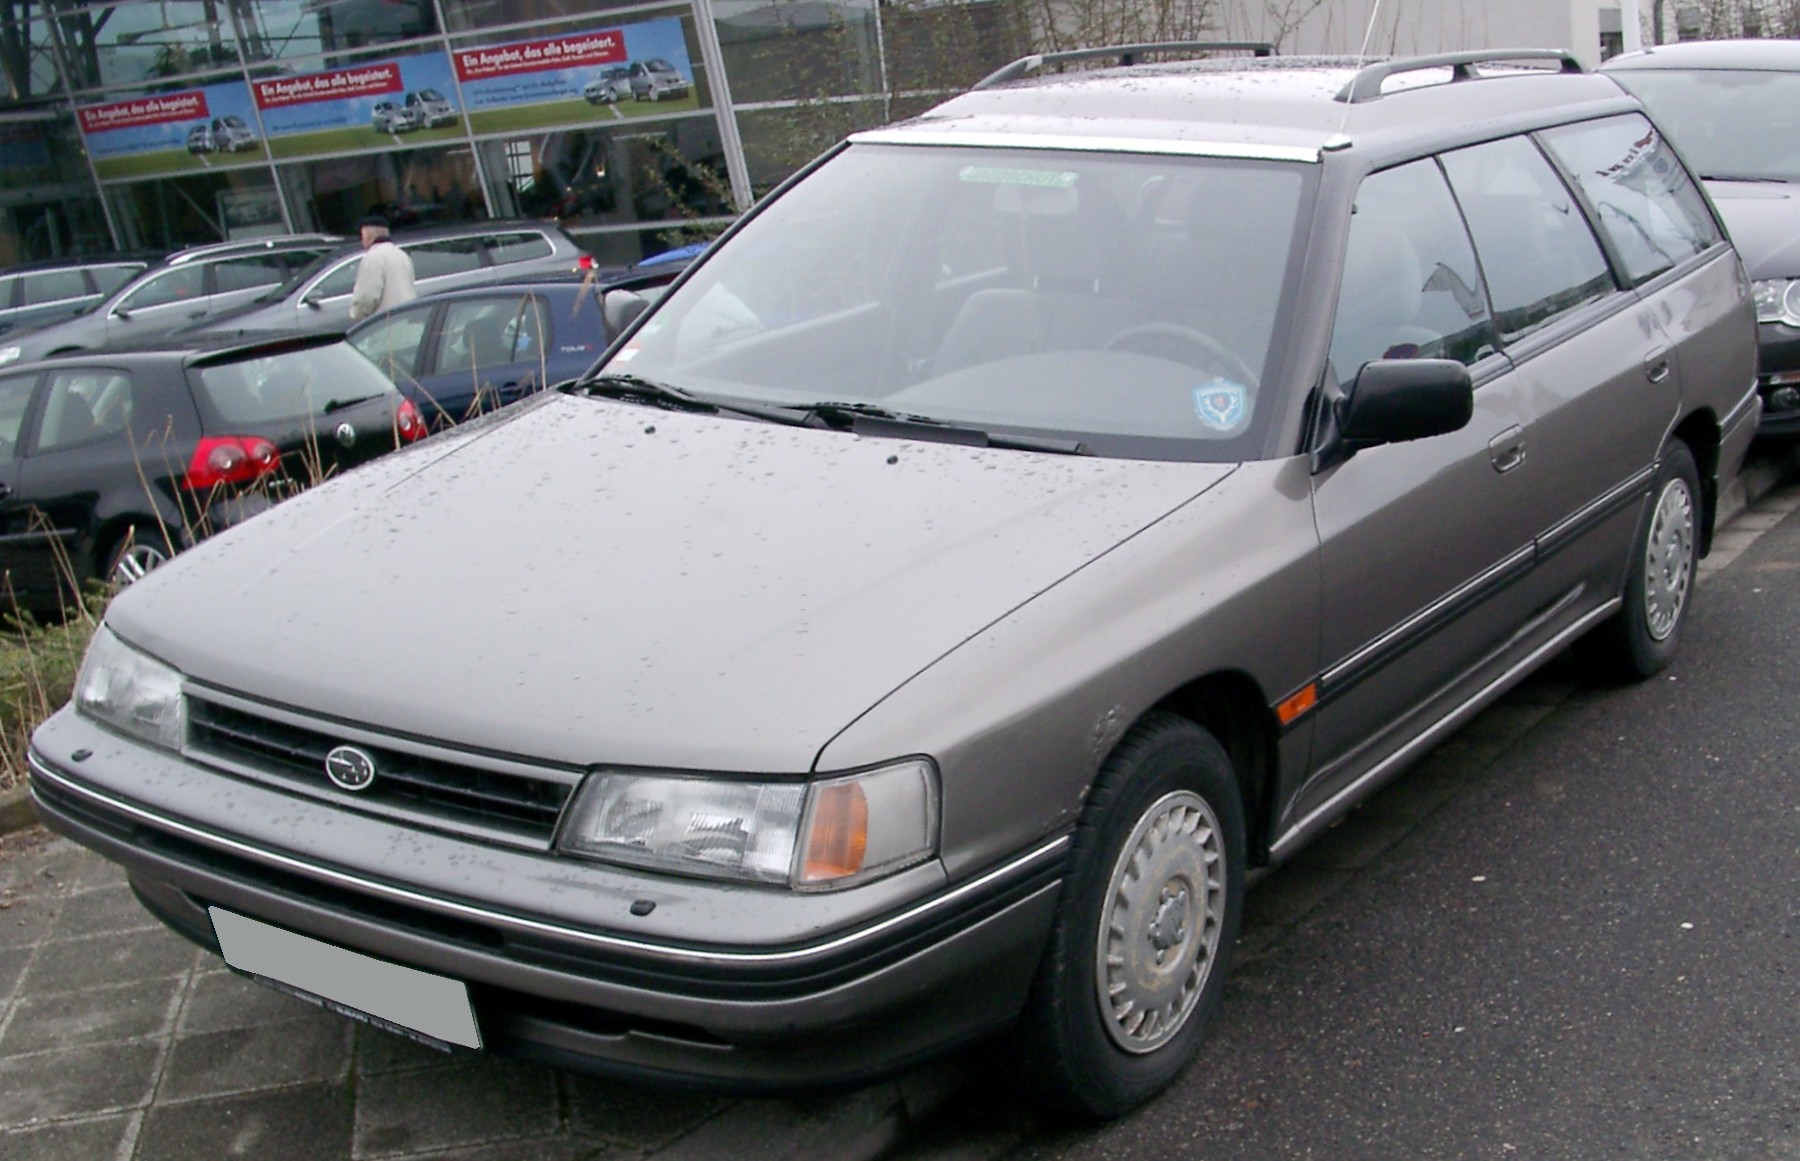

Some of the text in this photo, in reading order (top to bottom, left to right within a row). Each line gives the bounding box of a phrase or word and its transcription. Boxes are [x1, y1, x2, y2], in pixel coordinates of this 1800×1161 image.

[464, 54, 478, 67] Ein
[480, 50, 522, 66] Angebot,
[524, 46, 541, 58] das
[544, 43, 561, 55] alle
[563, 36, 614, 54] begeistert.
[261, 84, 275, 96] Ein
[314, 76, 329, 87] das
[348, 68, 392, 85] begeistert.
